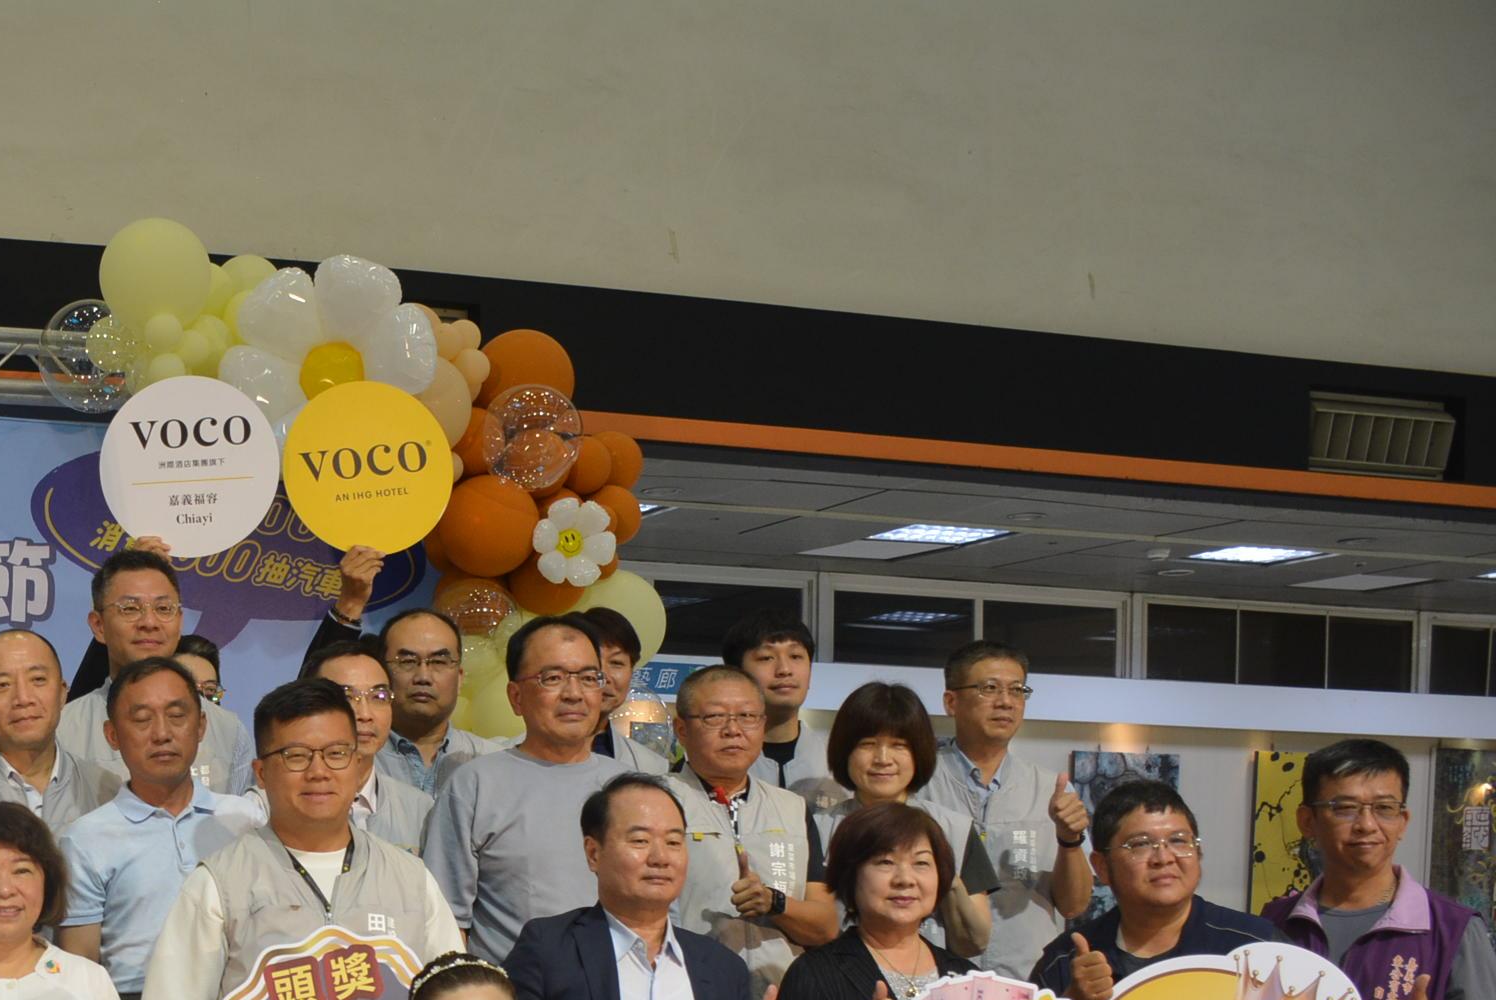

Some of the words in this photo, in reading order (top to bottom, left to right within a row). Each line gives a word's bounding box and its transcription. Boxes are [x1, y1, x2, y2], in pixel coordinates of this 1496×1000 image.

[335, 493, 351, 503] AN
[352, 490, 373, 501] IHG
[375, 487, 409, 499] HOTEL
[176, 513, 213, 526] Chiayi
